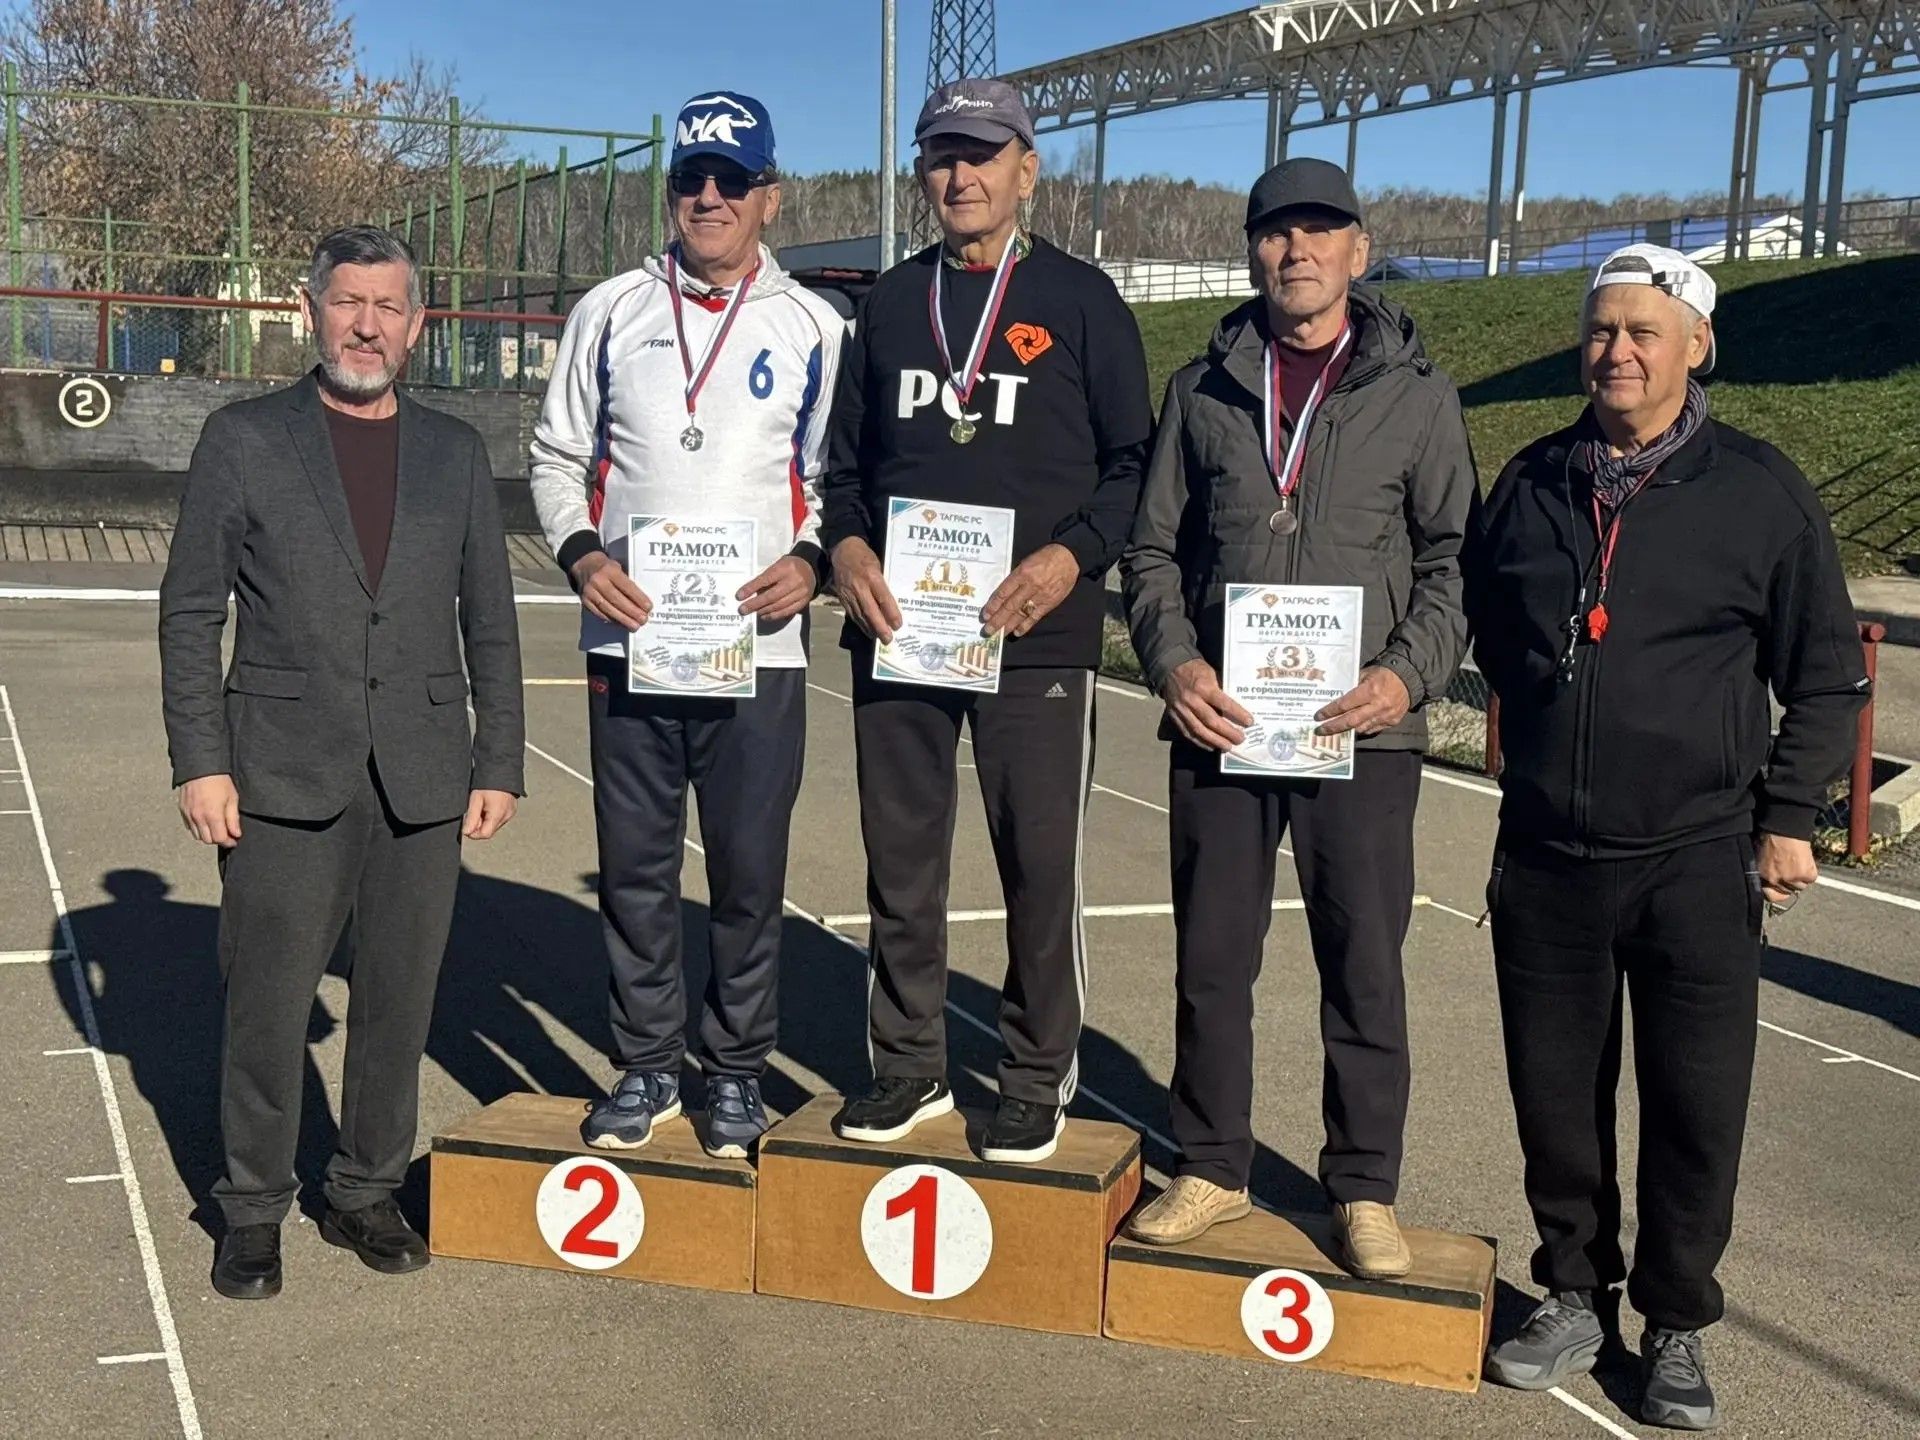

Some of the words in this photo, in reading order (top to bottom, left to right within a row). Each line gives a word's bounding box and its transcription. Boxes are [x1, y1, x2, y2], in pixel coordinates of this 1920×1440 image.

[749, 348, 774, 400] 6
[75, 389, 94, 416] 2
[898, 369, 1029, 425] РСТ
[940, 512, 970, 523] ТАГРАС
[971, 516, 983, 525] РС
[682, 526, 713, 534] ТАГРАС
[715, 526, 727, 535] РС
[908, 524, 993, 548] ГРАМОТА
[648, 541, 739, 558] ГРАМОТА
[684, 573, 702, 595] 2
[938, 561, 953, 584] 1
[1281, 596, 1315, 605] ТАГРАС
[1246, 612, 1342, 630] ГРАМОТА
[1281, 645, 1300, 668] 3
[560, 1164, 620, 1259] 2
[885, 1175, 939, 1294] 1
[1262, 1276, 1313, 1355] 3
